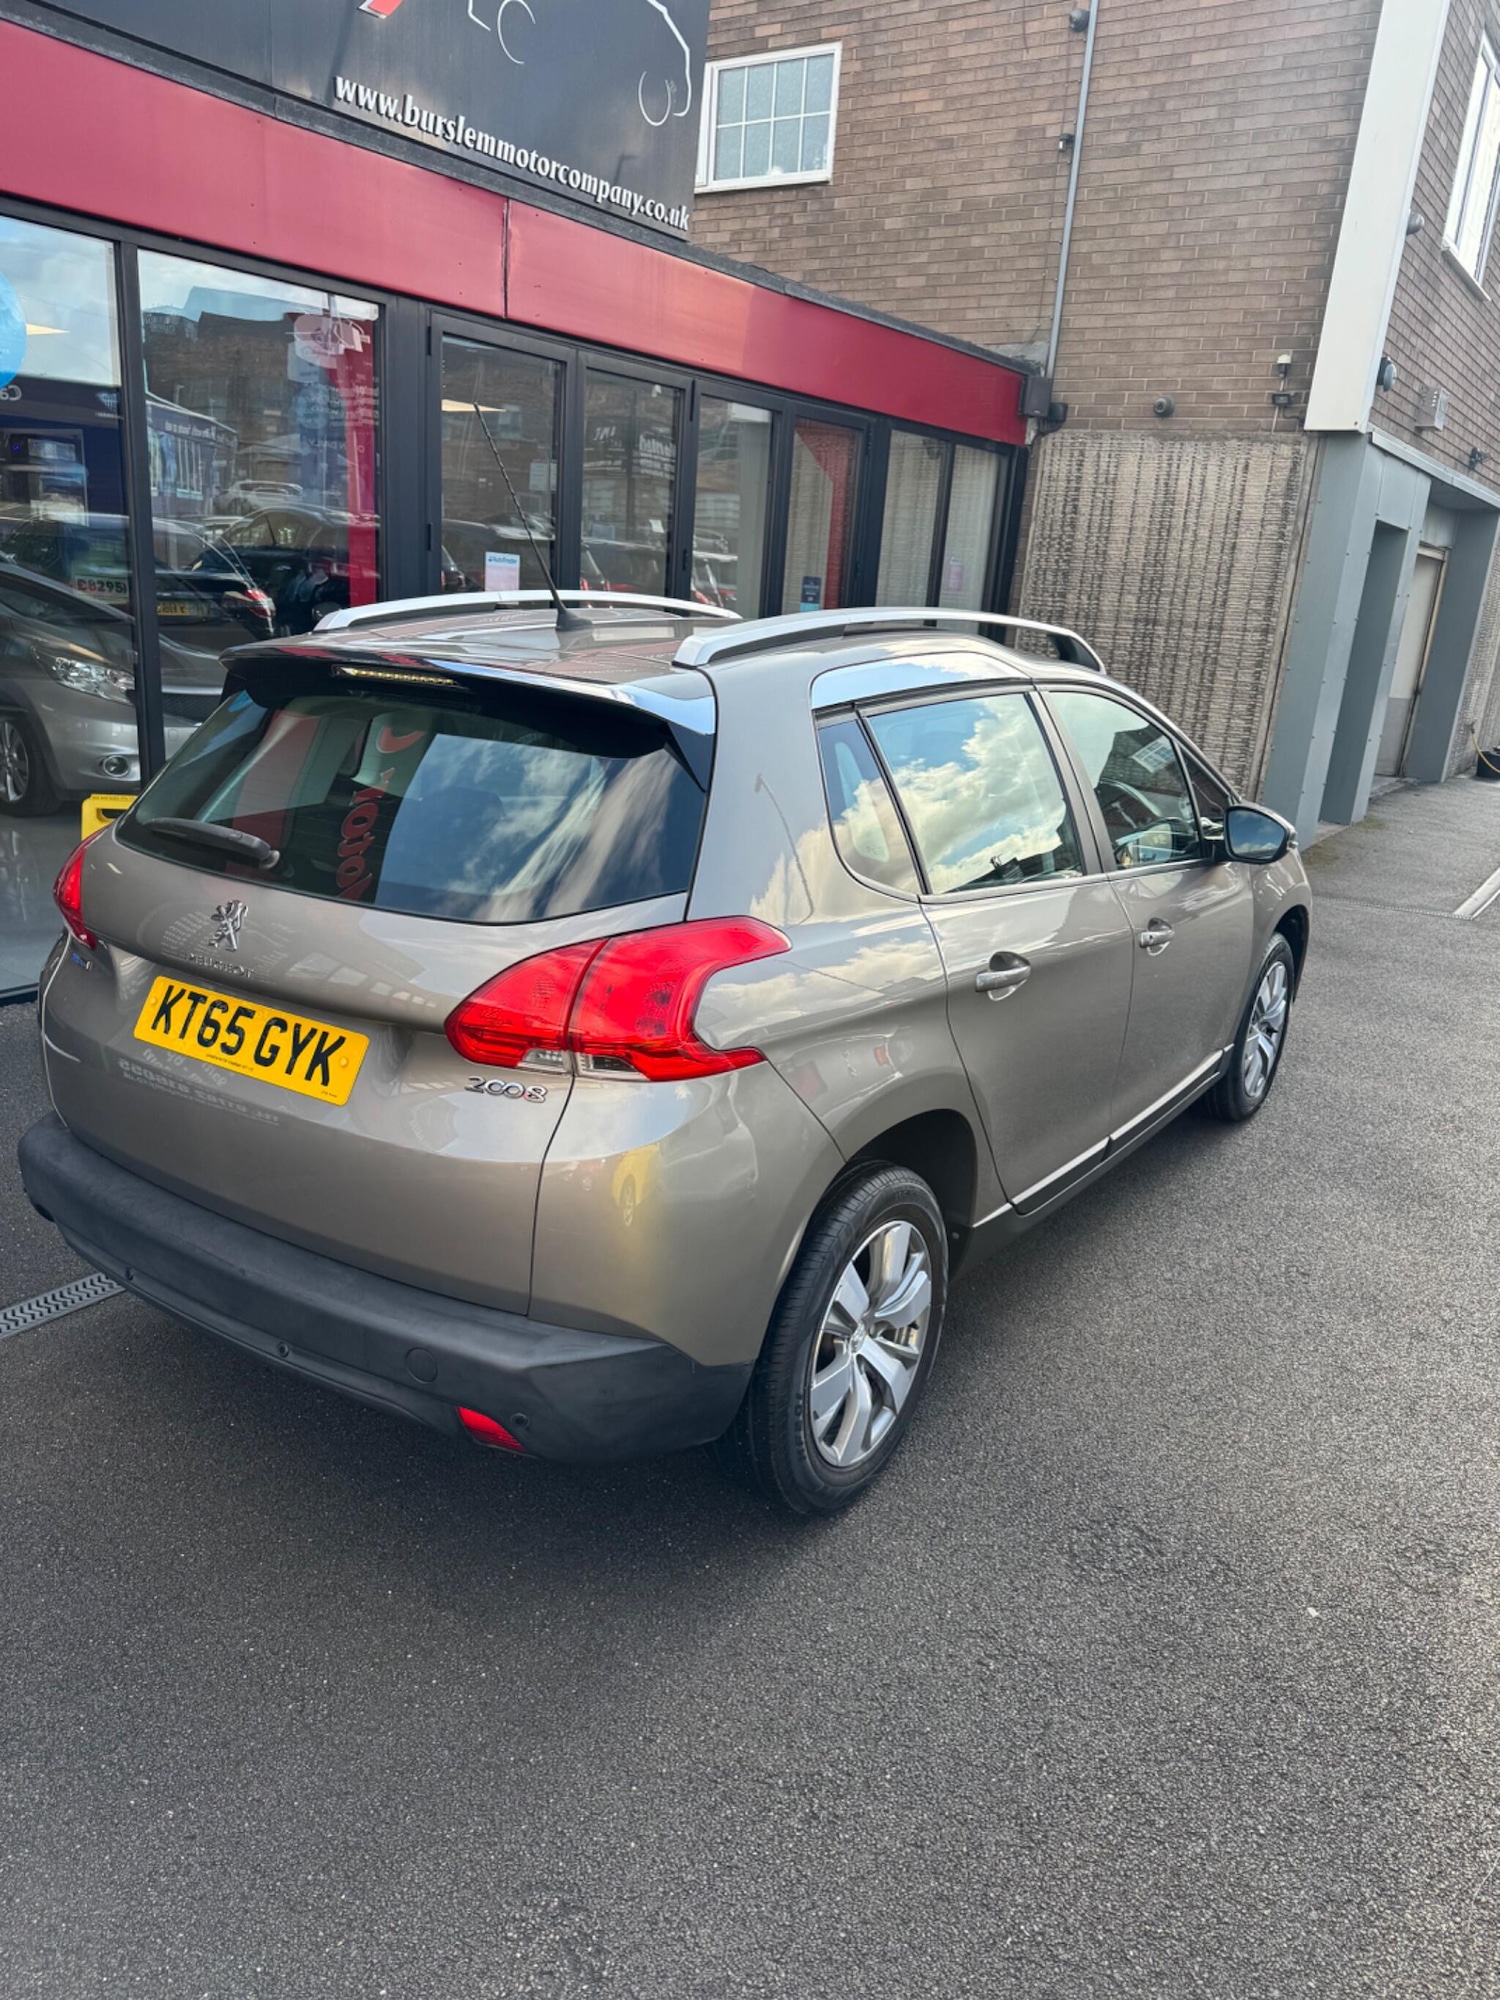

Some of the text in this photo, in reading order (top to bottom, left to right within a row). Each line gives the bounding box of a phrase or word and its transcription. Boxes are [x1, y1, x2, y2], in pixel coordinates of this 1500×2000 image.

[334, 75, 690, 231] www.burslemmotorcompany.co.uk
[150, 985, 256, 1056] KT65
[254, 1016, 346, 1087] GYK
[464, 1075, 549, 1104] 2008
